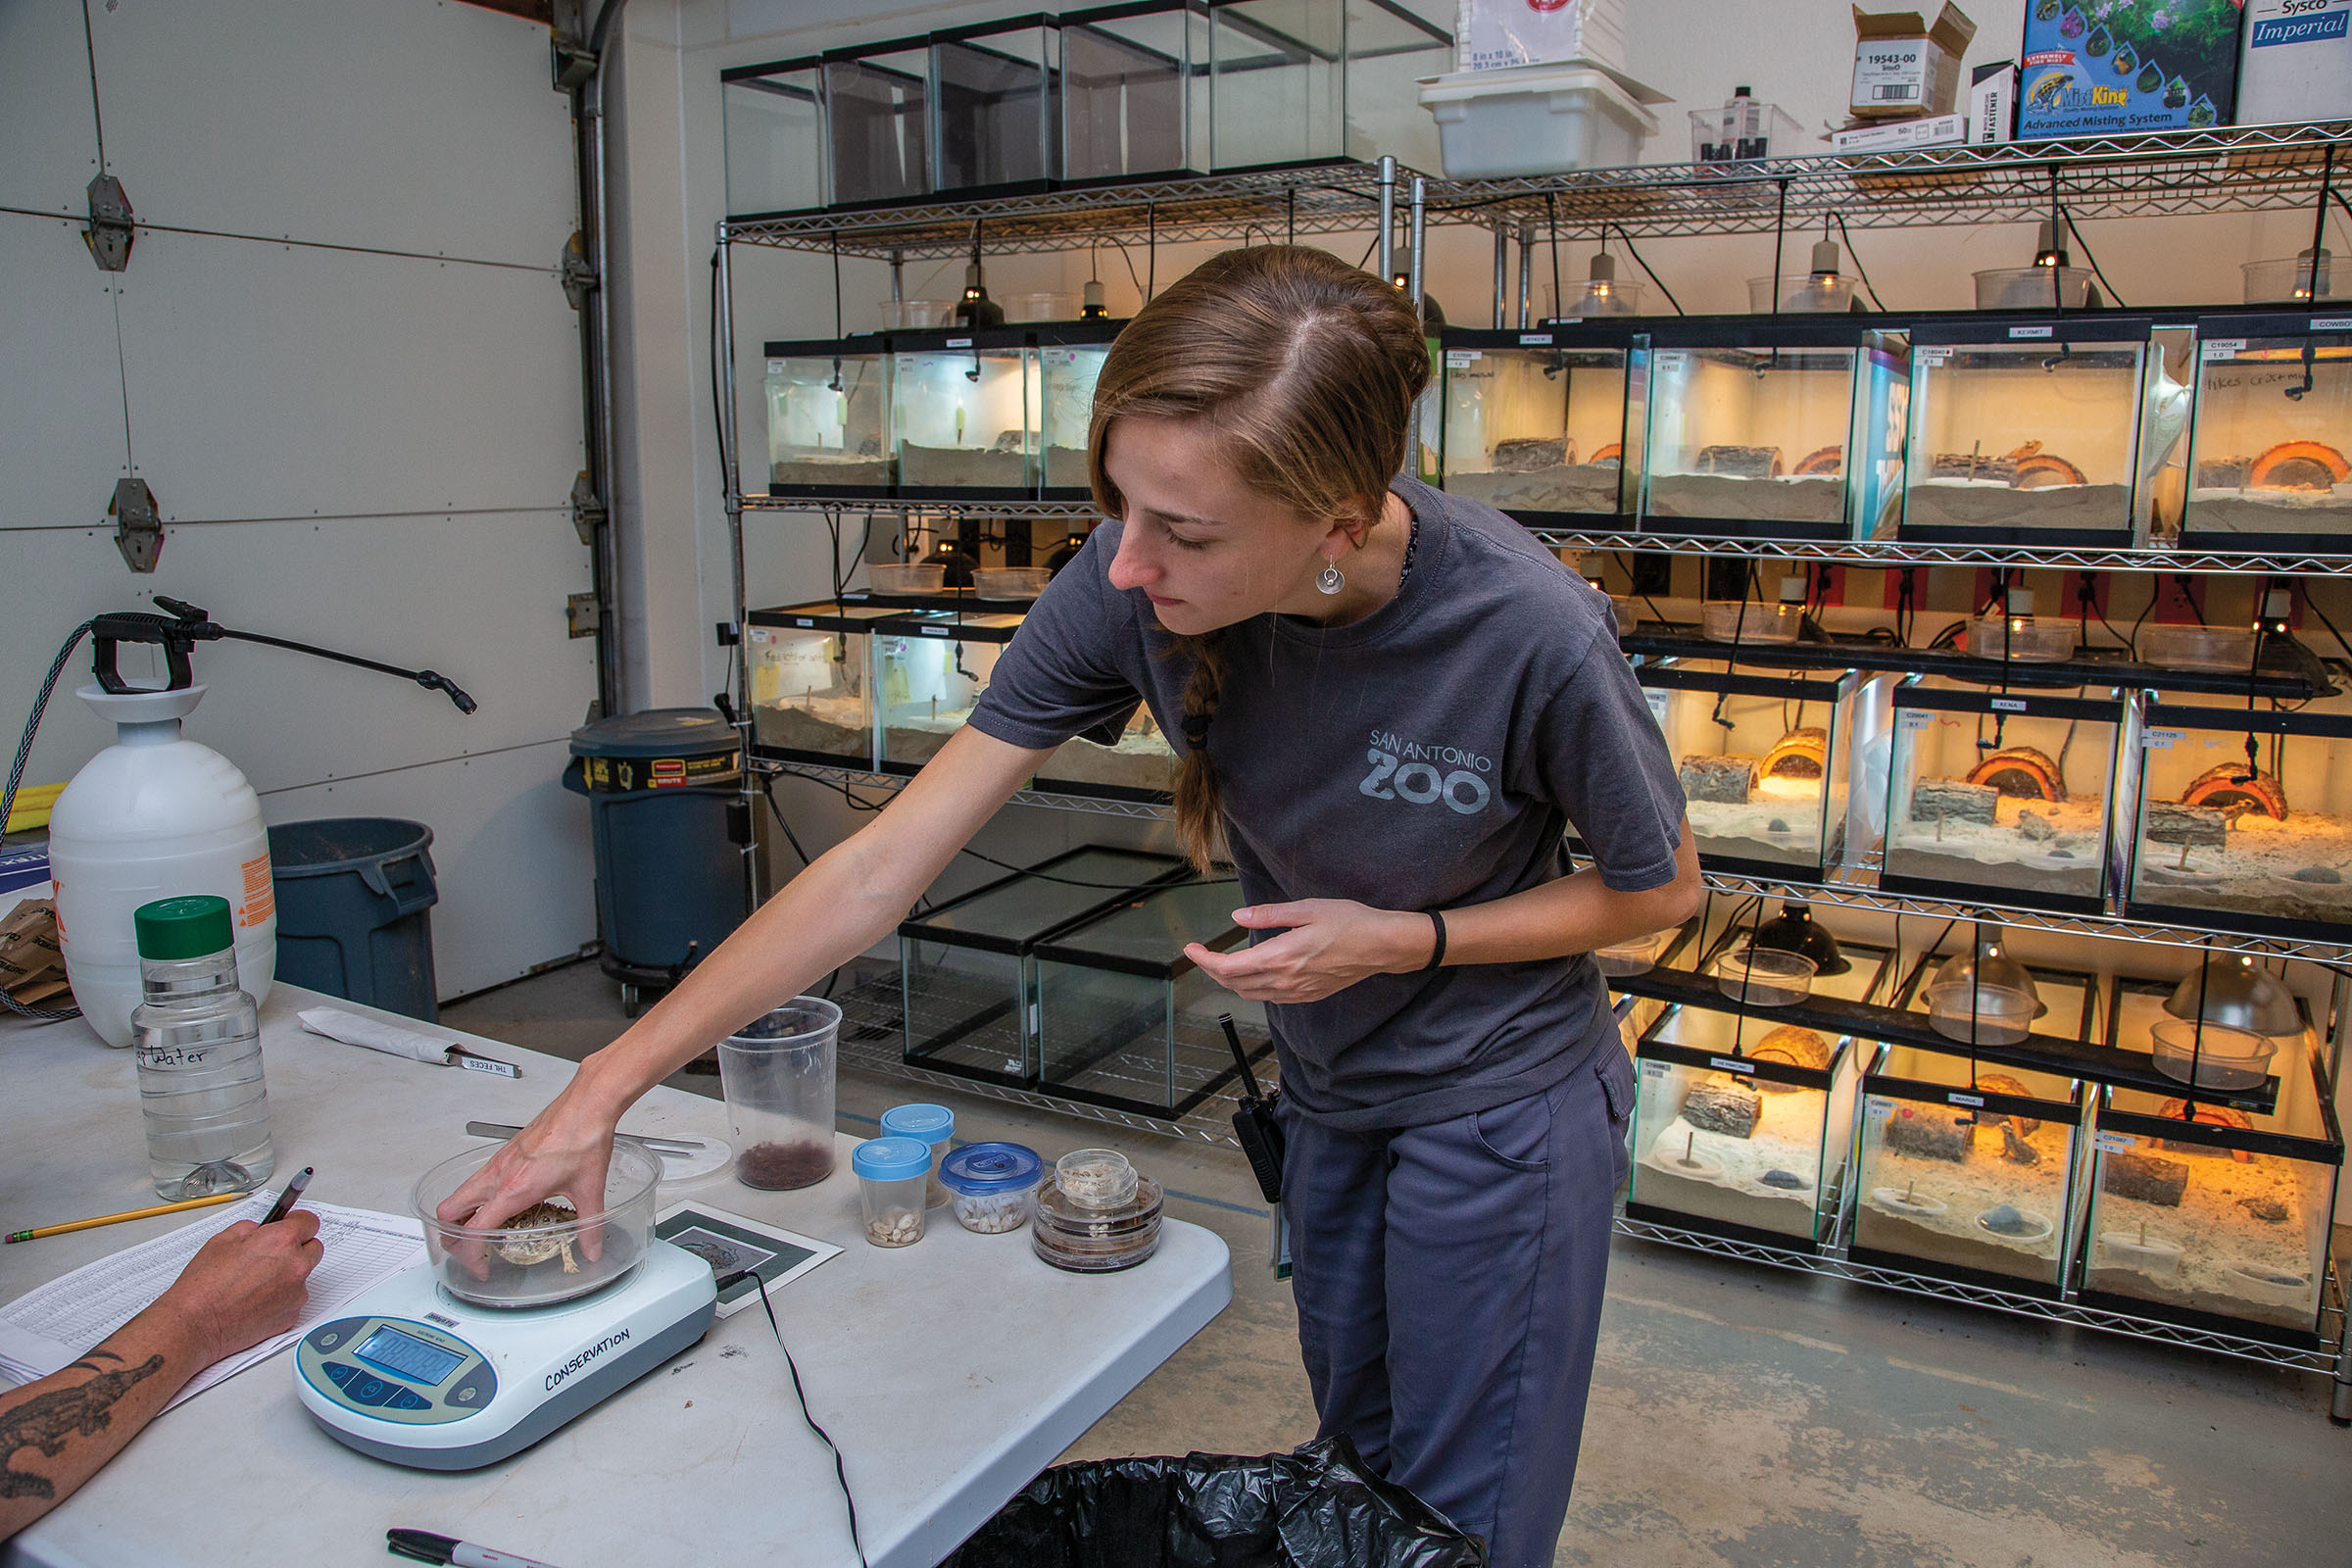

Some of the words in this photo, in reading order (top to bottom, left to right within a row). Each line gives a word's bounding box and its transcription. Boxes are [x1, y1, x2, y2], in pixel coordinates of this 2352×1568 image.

[2281, 0, 2328, 16] Sysco
[2254, 14, 2346, 41] Imperial
[1869, 54, 1917, 64] 19543-00
[1988, 91, 1998, 131] FASTENER
[2024, 117, 2081, 130] Advanced
[2082, 115, 2126, 126] Misting
[2129, 114, 2173, 124] System
[1370, 729, 1401, 753] SAN
[1402, 741, 1492, 772] ANTONIO
[1358, 748, 1491, 815] ZOO
[150, 1045, 208, 1066] Water
[470, 1060, 493, 1070] FECES
[545, 1328, 630, 1391] CONSERVATION
